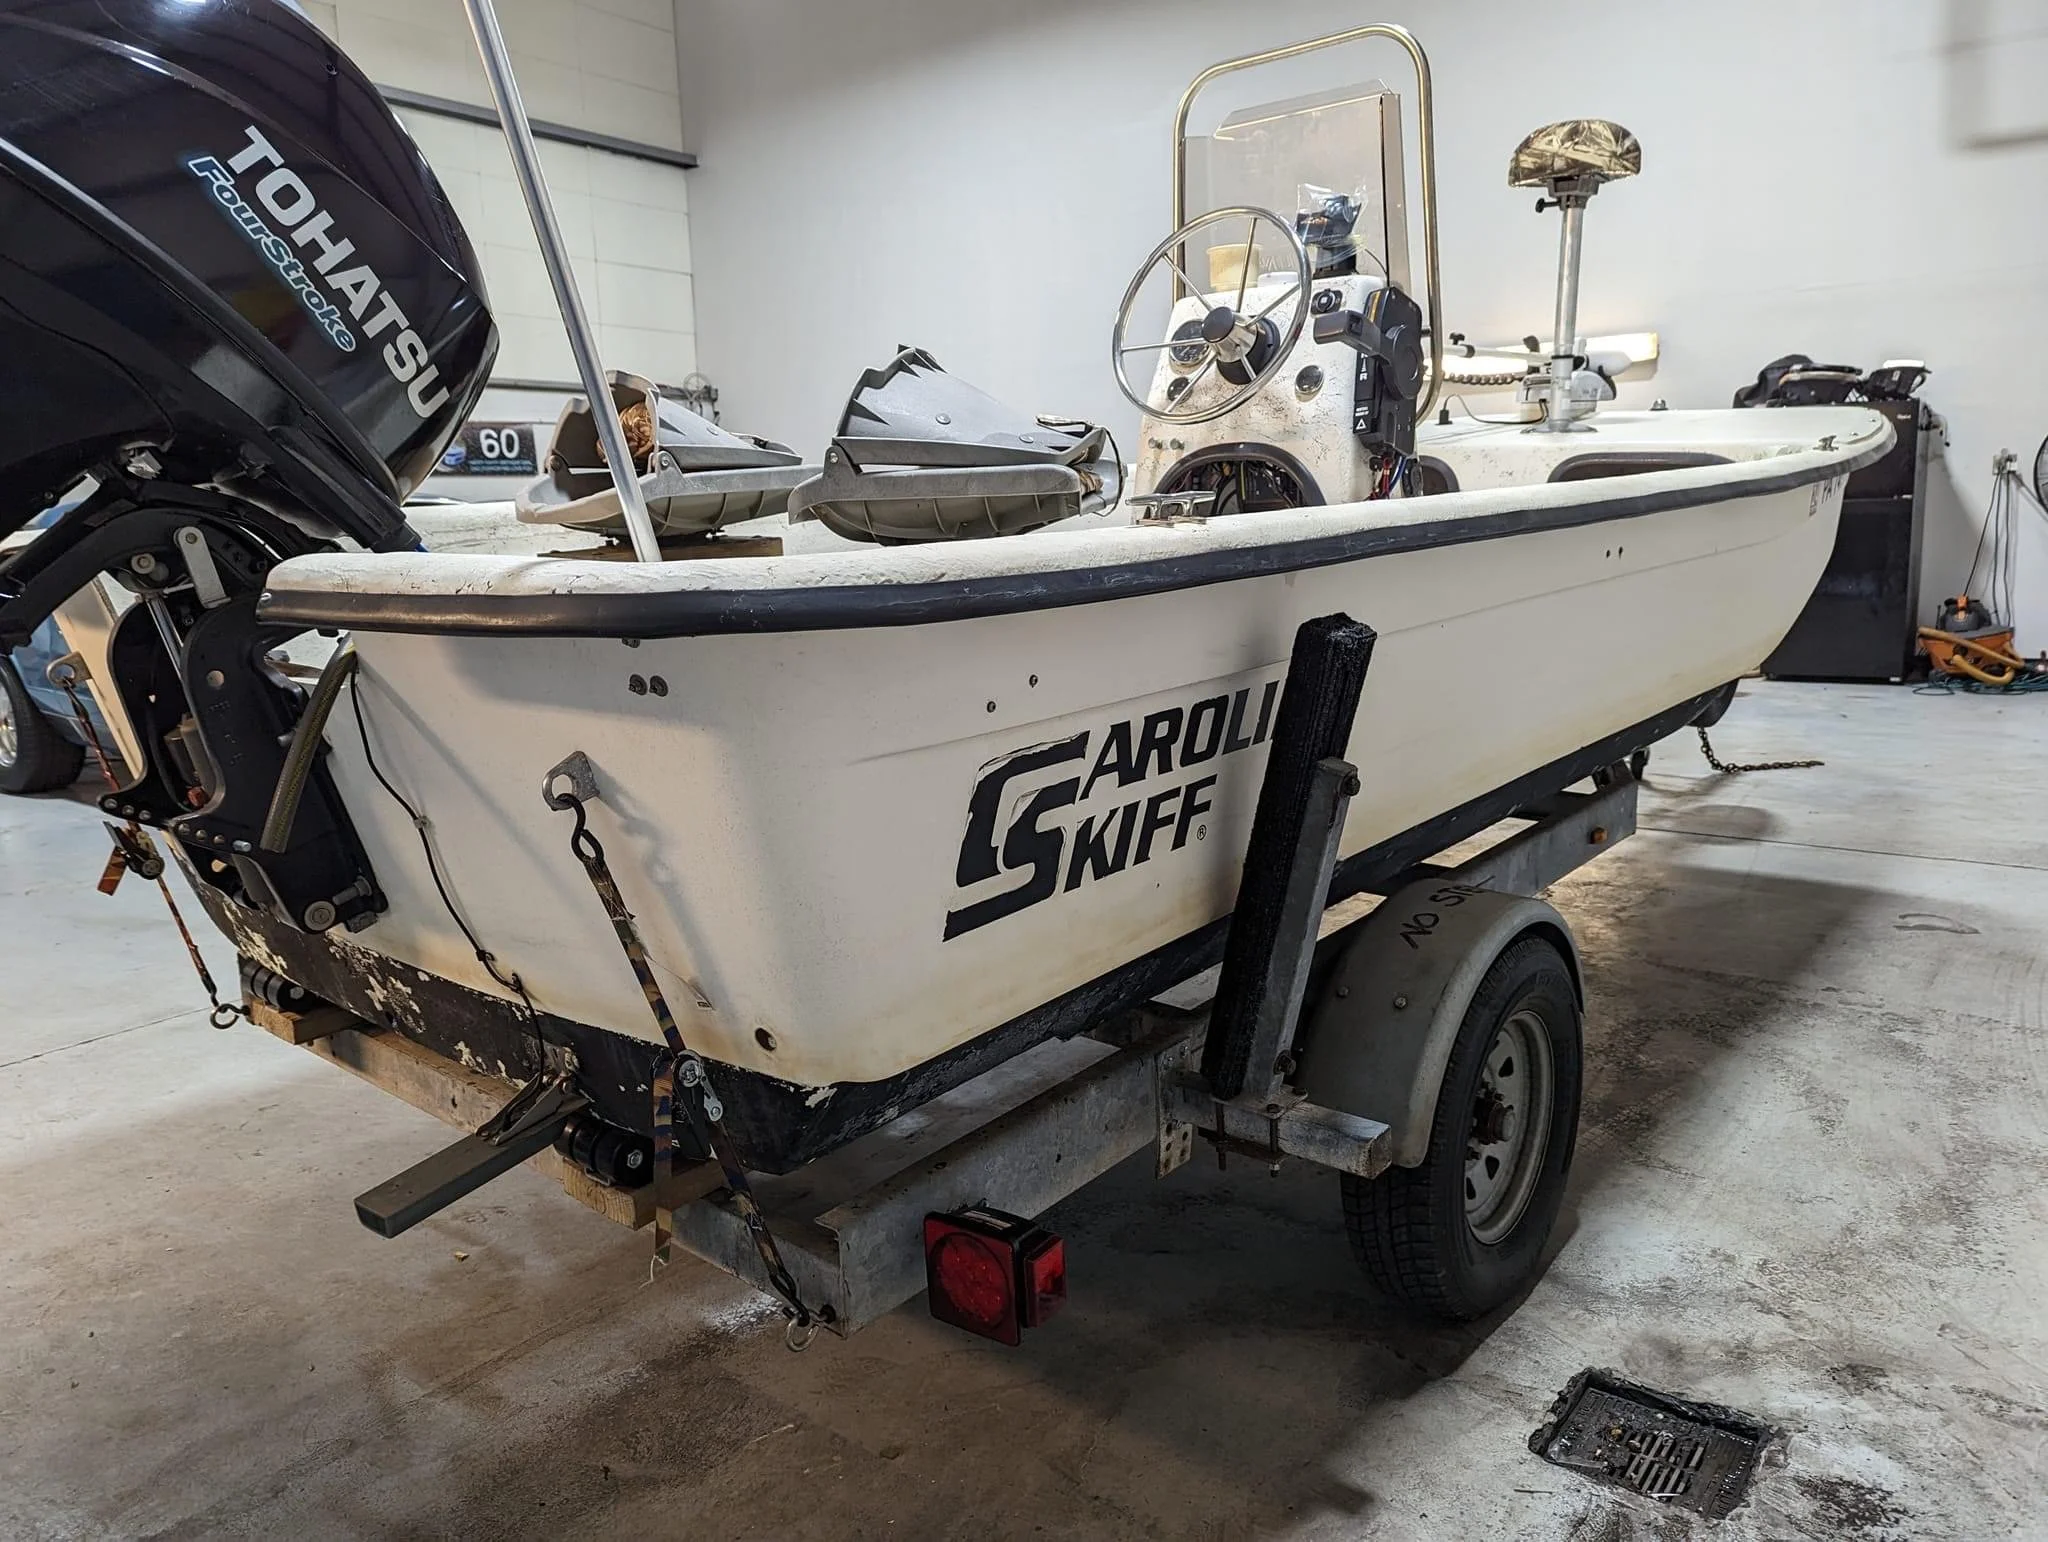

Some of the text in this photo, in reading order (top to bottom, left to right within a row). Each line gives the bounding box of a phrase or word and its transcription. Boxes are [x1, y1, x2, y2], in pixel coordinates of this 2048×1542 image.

[188, 156, 356, 352] FourStroke
[227, 125, 450, 418] TOHATSU
[479, 428, 520, 459] 60
[956, 680, 1280, 888] CAROLI
[1400, 913, 1440, 949] NO
